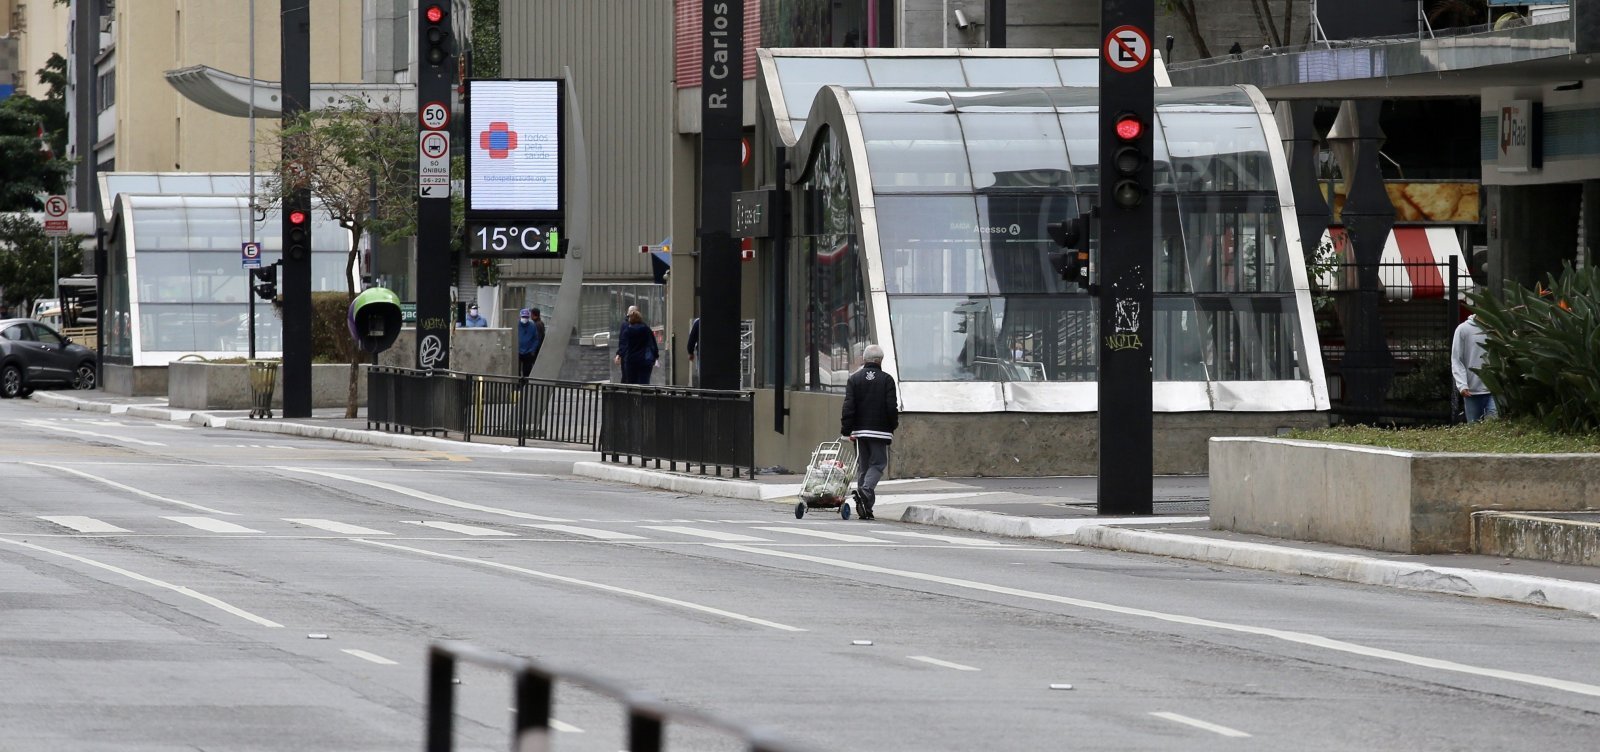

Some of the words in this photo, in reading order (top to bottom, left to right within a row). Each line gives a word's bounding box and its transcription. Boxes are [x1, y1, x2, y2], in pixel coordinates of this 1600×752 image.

[709, 2, 728, 79] Carlos
[1118, 37, 1137, 61] E
[709, 88, 727, 108] R.
[426, 109, 444, 120] 50
[524, 133, 548, 142] todos
[1512, 118, 1526, 147] Raia
[476, 227, 541, 251] 15°C
[973, 225, 1007, 233] Acesso
[248, 246, 255, 256] E
